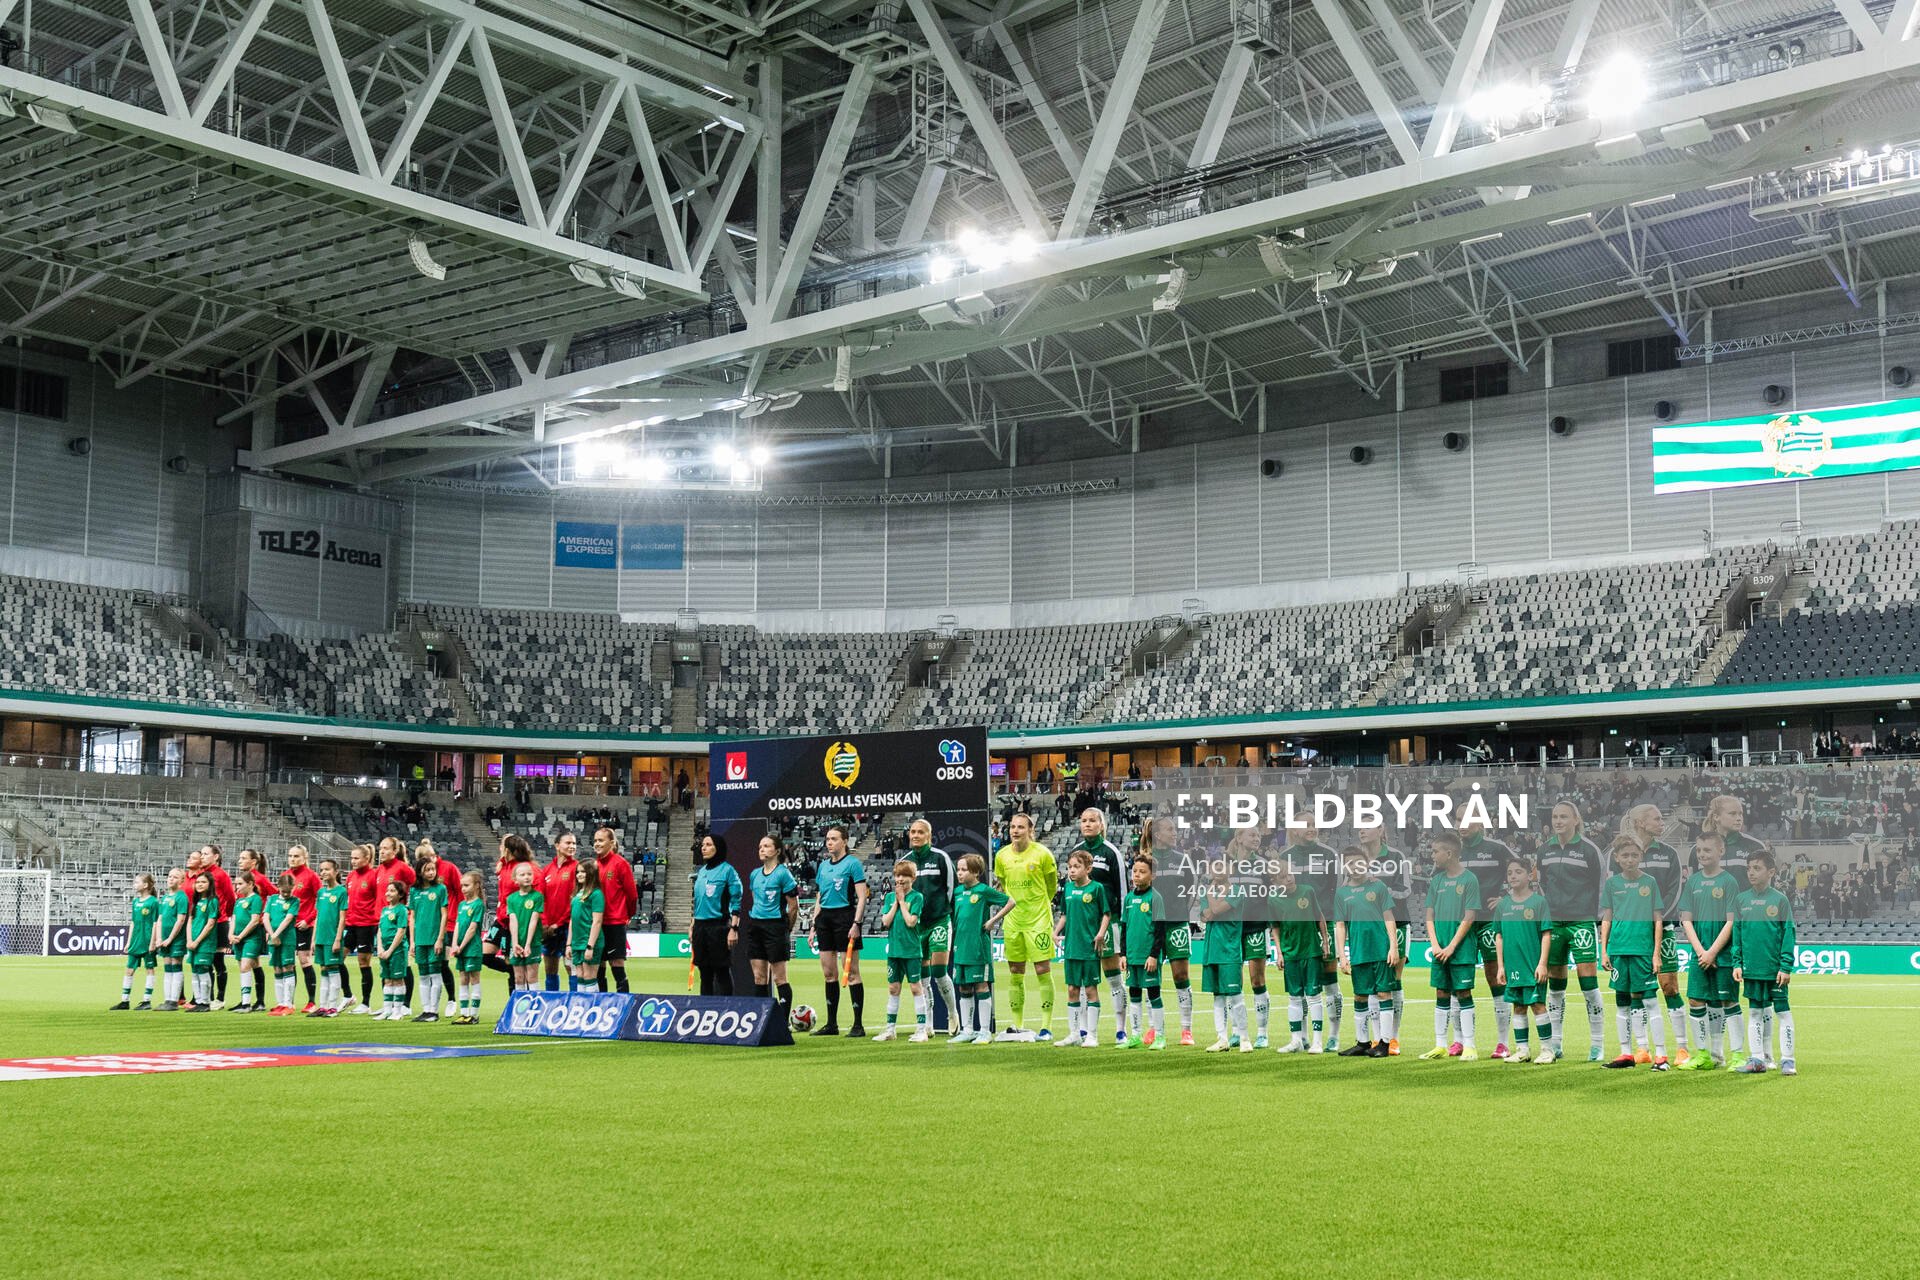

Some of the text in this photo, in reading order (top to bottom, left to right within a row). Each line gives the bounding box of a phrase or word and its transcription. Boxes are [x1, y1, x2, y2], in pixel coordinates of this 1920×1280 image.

[258, 530, 382, 568] TELE2 Arena
[558, 535, 613, 546] AMERICAN
[566, 545, 615, 555] EXPRESS
[1753, 574, 1775, 585] B309
[936, 766, 974, 780] OBOS
[715, 781, 759, 791] SVENSKA SPEL
[768, 792, 922, 811] OBOS DAMALLSVENSKAN
[53, 927, 126, 953] Convini
[1793, 945, 1851, 968] lean
[547, 1005, 619, 1032] OBOS
[676, 1010, 758, 1038] OBOS
